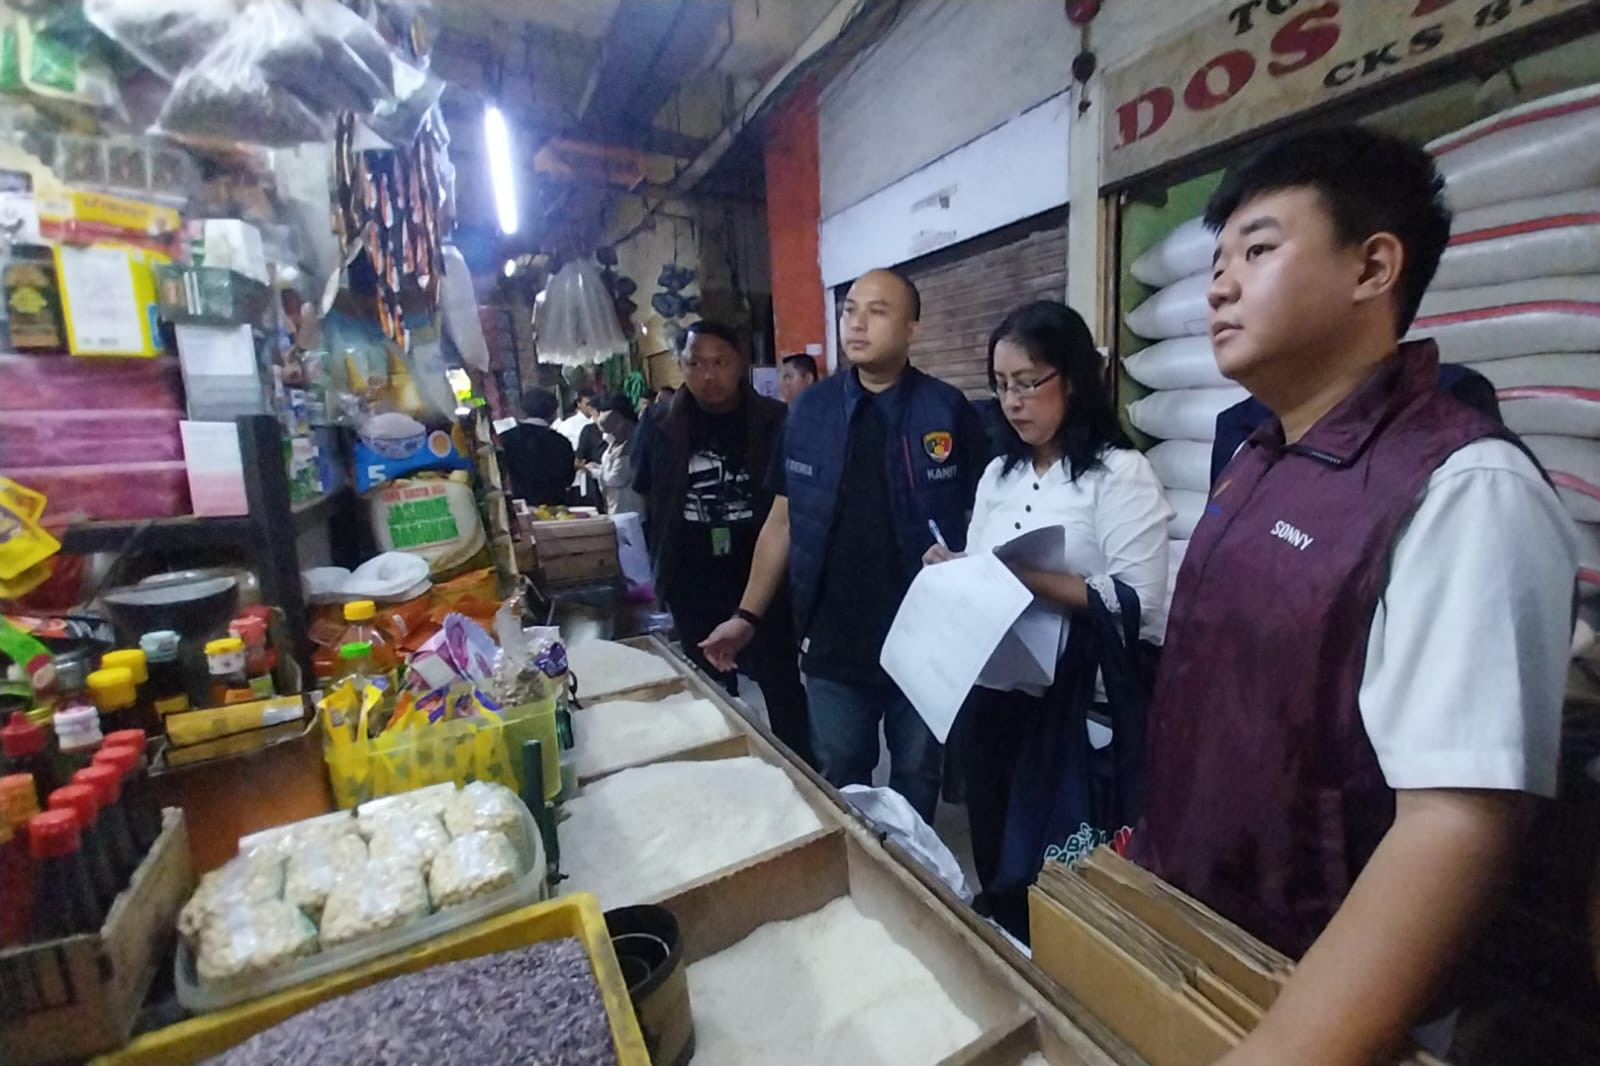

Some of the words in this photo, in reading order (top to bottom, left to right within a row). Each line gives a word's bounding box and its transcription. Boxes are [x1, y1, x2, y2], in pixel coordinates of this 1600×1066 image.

[1112, 1, 1342, 151] DOS
[367, 463, 387, 487] 5
[1269, 519, 1315, 551] SONNY
